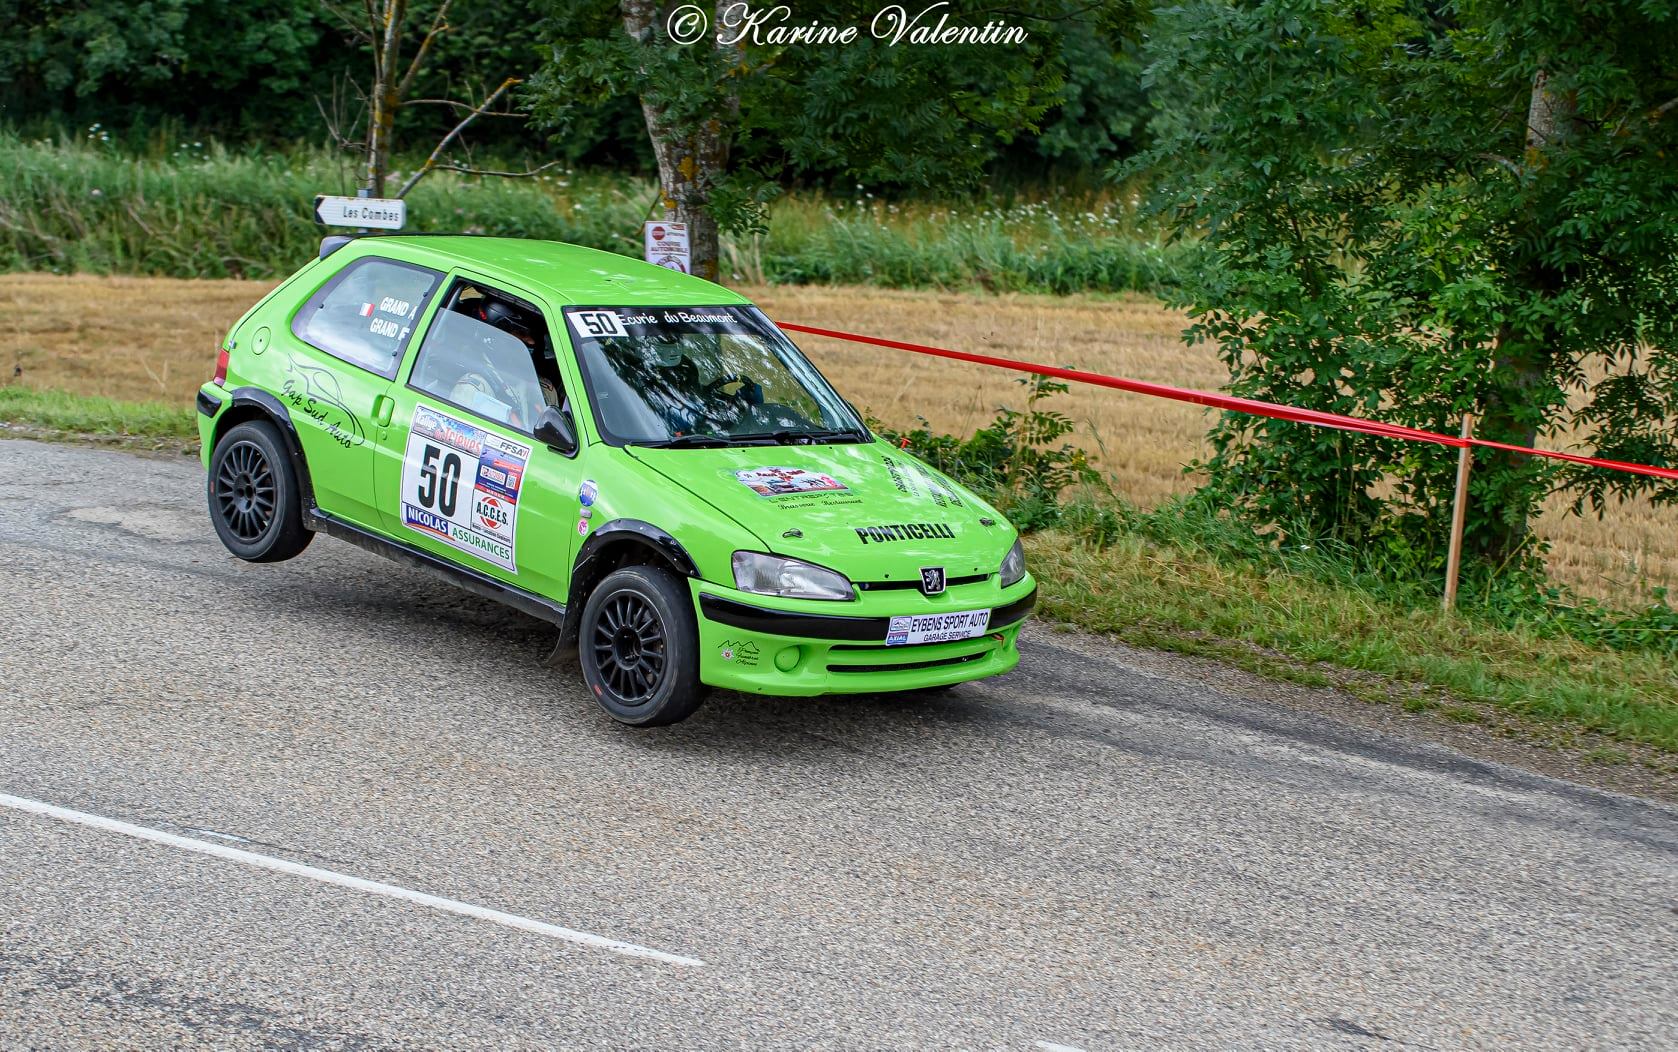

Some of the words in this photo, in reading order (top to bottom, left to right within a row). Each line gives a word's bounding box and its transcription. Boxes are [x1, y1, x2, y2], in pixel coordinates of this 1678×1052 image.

[343, 206, 358, 218] Les
[362, 207, 399, 221] Combes
[380, 296, 409, 316] GRAND
[408, 305, 418, 320] A
[618, 312, 658, 326] Ecurie
[664, 310, 679, 323] du
[680, 311, 738, 324] Beaumont
[370, 317, 399, 338] GRAND
[580, 313, 618, 334] 50
[281, 379, 303, 406] Gap
[304, 397, 328, 422] Sud
[325, 421, 351, 448] Auto
[500, 441, 523, 457] FFSA
[418, 444, 462, 517] 50
[476, 501, 509, 525] A.C.C.E.S.
[408, 506, 447, 532] NICOLAS
[452, 527, 510, 559] ASSURANCES
[854, 523, 956, 544] PONTICELLI
[911, 617, 943, 632] EYBENS
[943, 614, 969, 630] SPORT
[968, 612, 989, 627] AUTO
[924, 632, 947, 642] GARAGE
[947, 630, 972, 640] SERVICE
